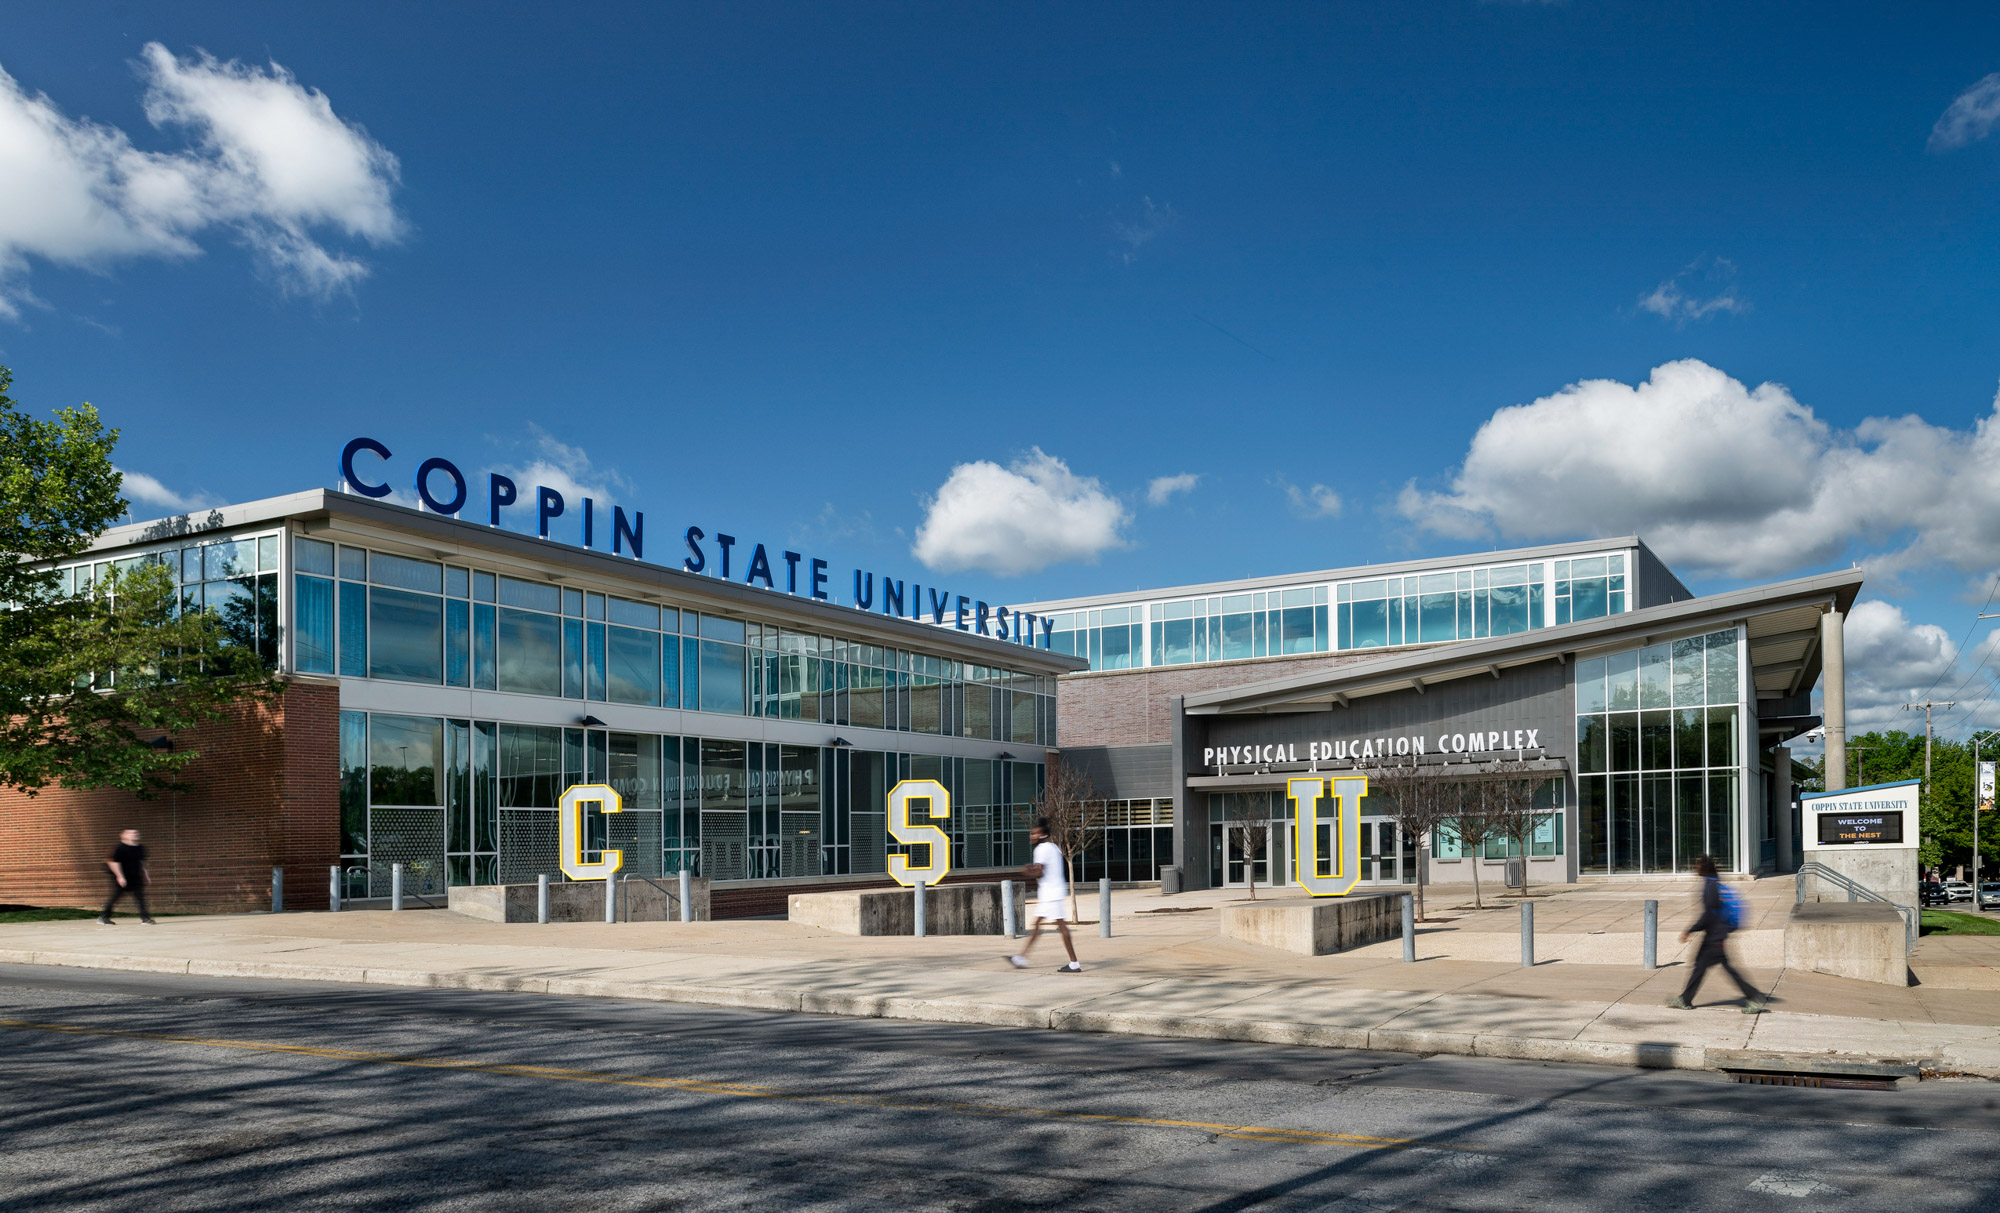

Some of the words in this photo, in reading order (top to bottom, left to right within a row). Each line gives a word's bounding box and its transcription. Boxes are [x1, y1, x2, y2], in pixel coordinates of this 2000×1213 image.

[338, 437, 643, 559] COPPIN
[684, 526, 828, 600] STATE
[853, 569, 1055, 649] UNIVERSITY
[1203, 742, 1298, 767] PHYSICAL
[1309, 735, 1425, 762] EDUCATION
[1438, 729, 1539, 754] COMPLEX
[558, 783, 623, 881] C
[887, 779, 951, 887] S
[1286, 775, 1369, 897] U
[1811, 802, 1837, 812] COPPIN
[1839, 801, 1863, 811] STATE
[1864, 799, 1909, 810] UNIVERSITY
